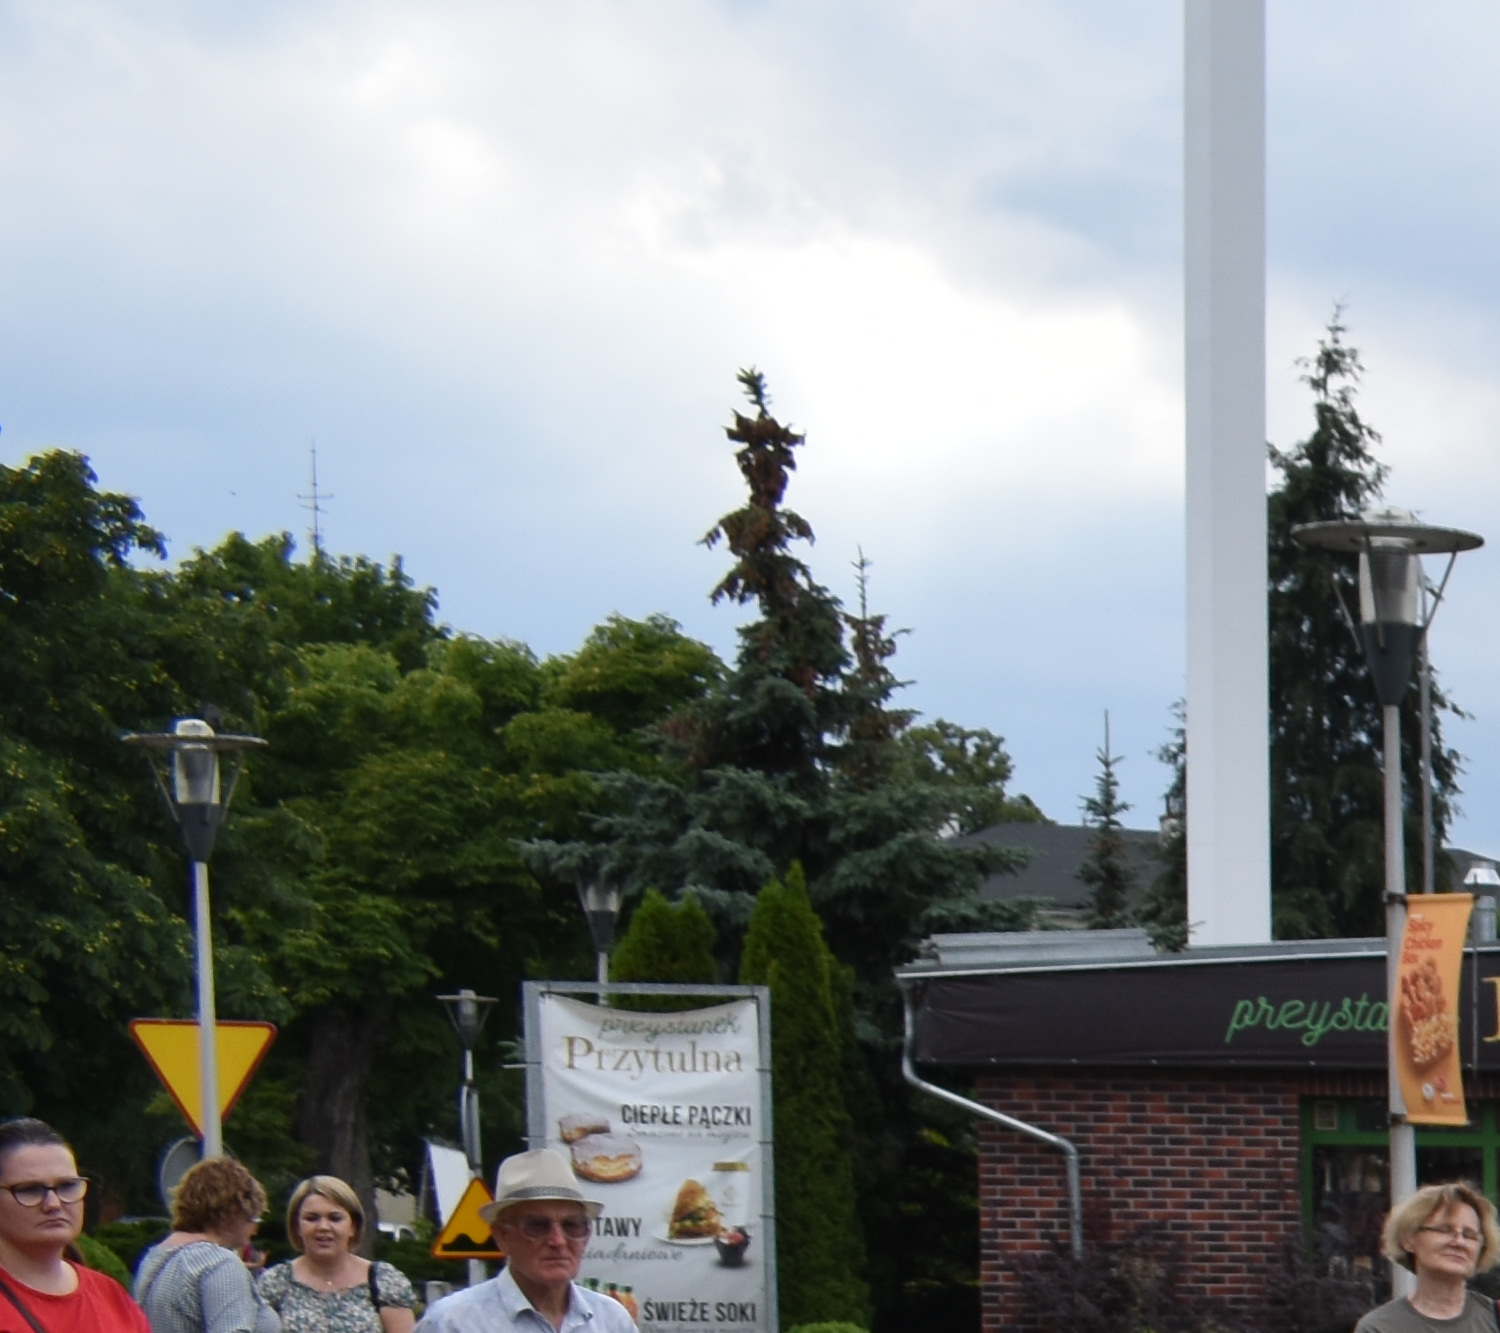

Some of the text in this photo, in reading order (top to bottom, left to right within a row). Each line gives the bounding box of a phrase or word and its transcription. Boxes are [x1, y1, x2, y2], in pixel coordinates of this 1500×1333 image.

[562, 1035, 744, 1080] Przytulna
[643, 1297, 757, 1322] ŚWIEŻE SOKI
